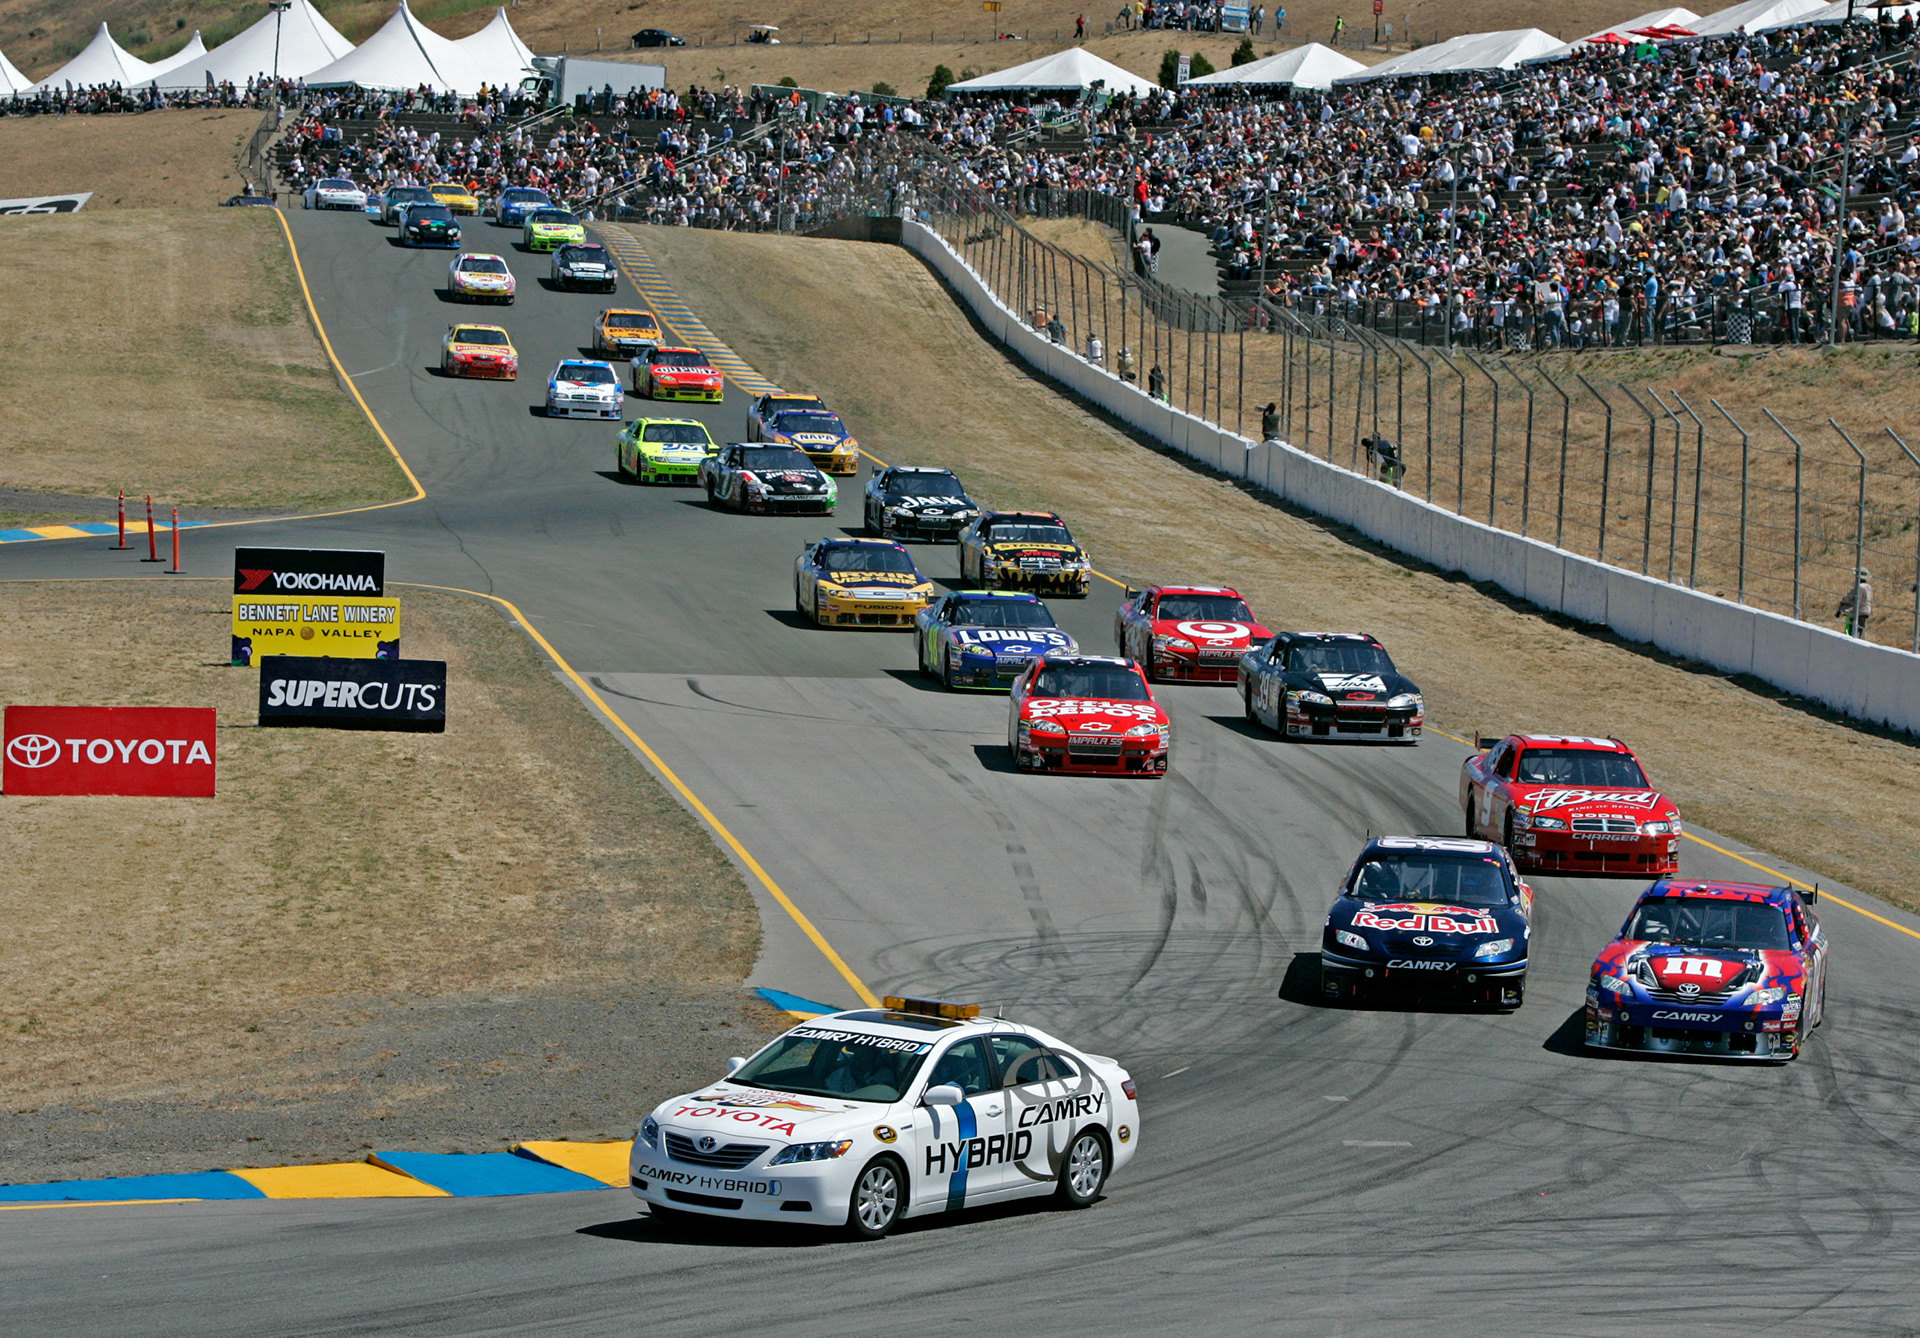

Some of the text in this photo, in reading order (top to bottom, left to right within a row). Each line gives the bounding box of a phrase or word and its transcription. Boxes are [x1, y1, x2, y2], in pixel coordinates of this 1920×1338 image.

[800, 434, 834, 442] NAPA
[765, 472, 784, 480] JIM
[785, 470, 818, 479] BEAM
[901, 496, 966, 508] JACK
[273, 572, 377, 592] YOKOHAMA
[830, 572, 916, 580] IRWIN
[238, 604, 396, 624] BENNETT LANE WINERY
[252, 628, 383, 639] NAPA VALLEY
[959, 630, 1066, 646] LOWE'S
[1198, 650, 1231, 658] IMPALA
[267, 679, 436, 712] SUPERCUTS
[1257, 671, 1272, 711] 39
[1028, 699, 1156, 714] Office
[1030, 706, 1157, 722] DEPOT
[1068, 736, 1124, 746] IMPALA SS
[66, 738, 212, 765] TOYOTA
[1571, 812, 1636, 820] DODGE
[1572, 832, 1640, 842] CHARGER
[1351, 911, 1500, 934] Red Bull
[1386, 959, 1457, 972] CAMRY
[1662, 957, 1723, 978] m
[1652, 1010, 1724, 1022] CAMRY
[788, 1028, 919, 1052] CAMRY HYBRID
[747, 1088, 797, 1099] TOYOTA
[1018, 1092, 1104, 1128] CAMRY
[674, 1106, 796, 1137] TOYOTA
[925, 1130, 1032, 1176] HYBRID
[639, 1164, 768, 1195] CAMRY HYBRID
